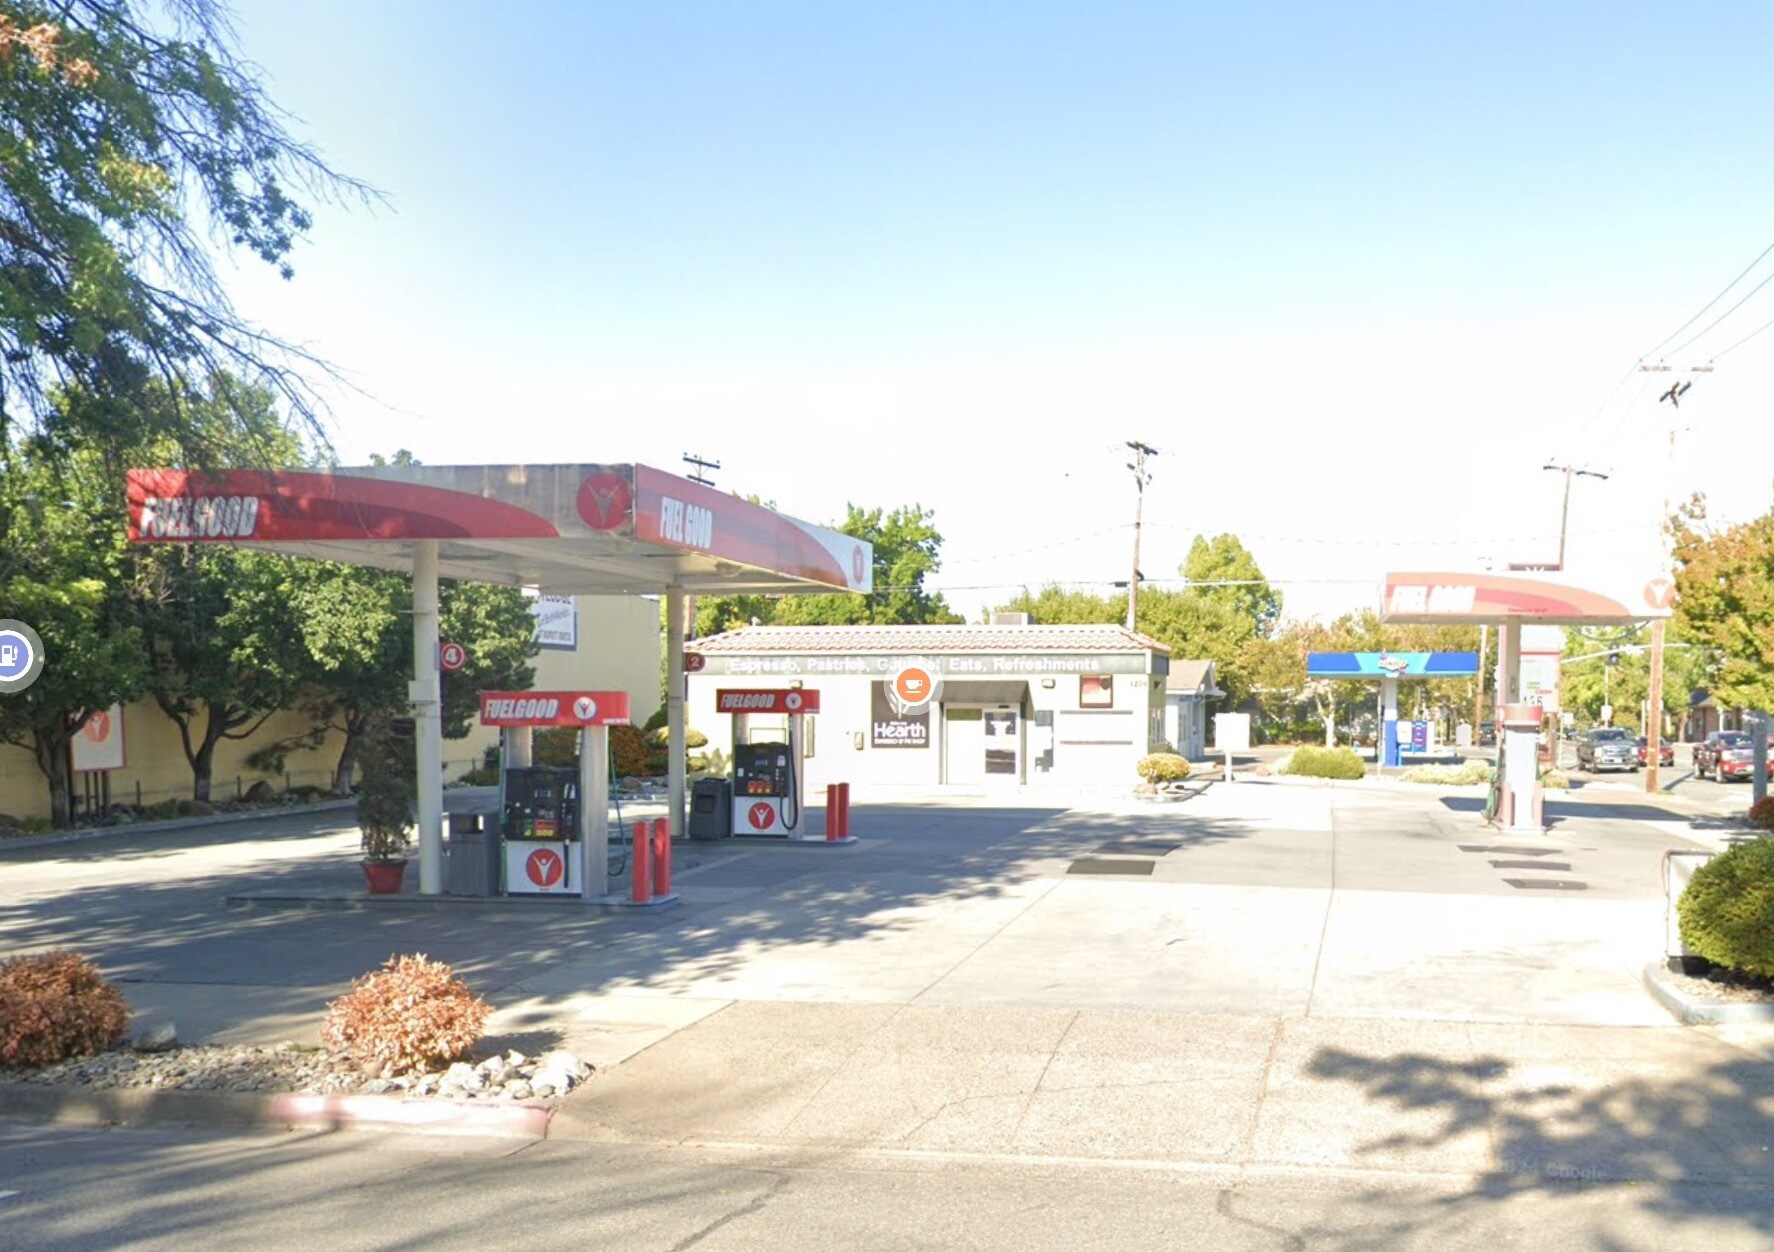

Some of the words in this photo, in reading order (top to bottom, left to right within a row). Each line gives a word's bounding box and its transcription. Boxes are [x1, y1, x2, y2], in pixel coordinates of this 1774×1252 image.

[660, 496, 684, 543] FUEL
[685, 503, 713, 549] GOOD
[445, 648, 458, 663] 4
[690, 655, 700, 667] 2
[730, 658, 800, 674] Espresso,
[807, 658, 870, 673] Pastries,
[950, 657, 987, 672] Eats,
[993, 656, 1100, 671] Refreshments
[484, 698, 559, 719] FUELGOOD
[721, 693, 776, 708] FUELGOOD
[873, 722, 927, 738] Hearth
